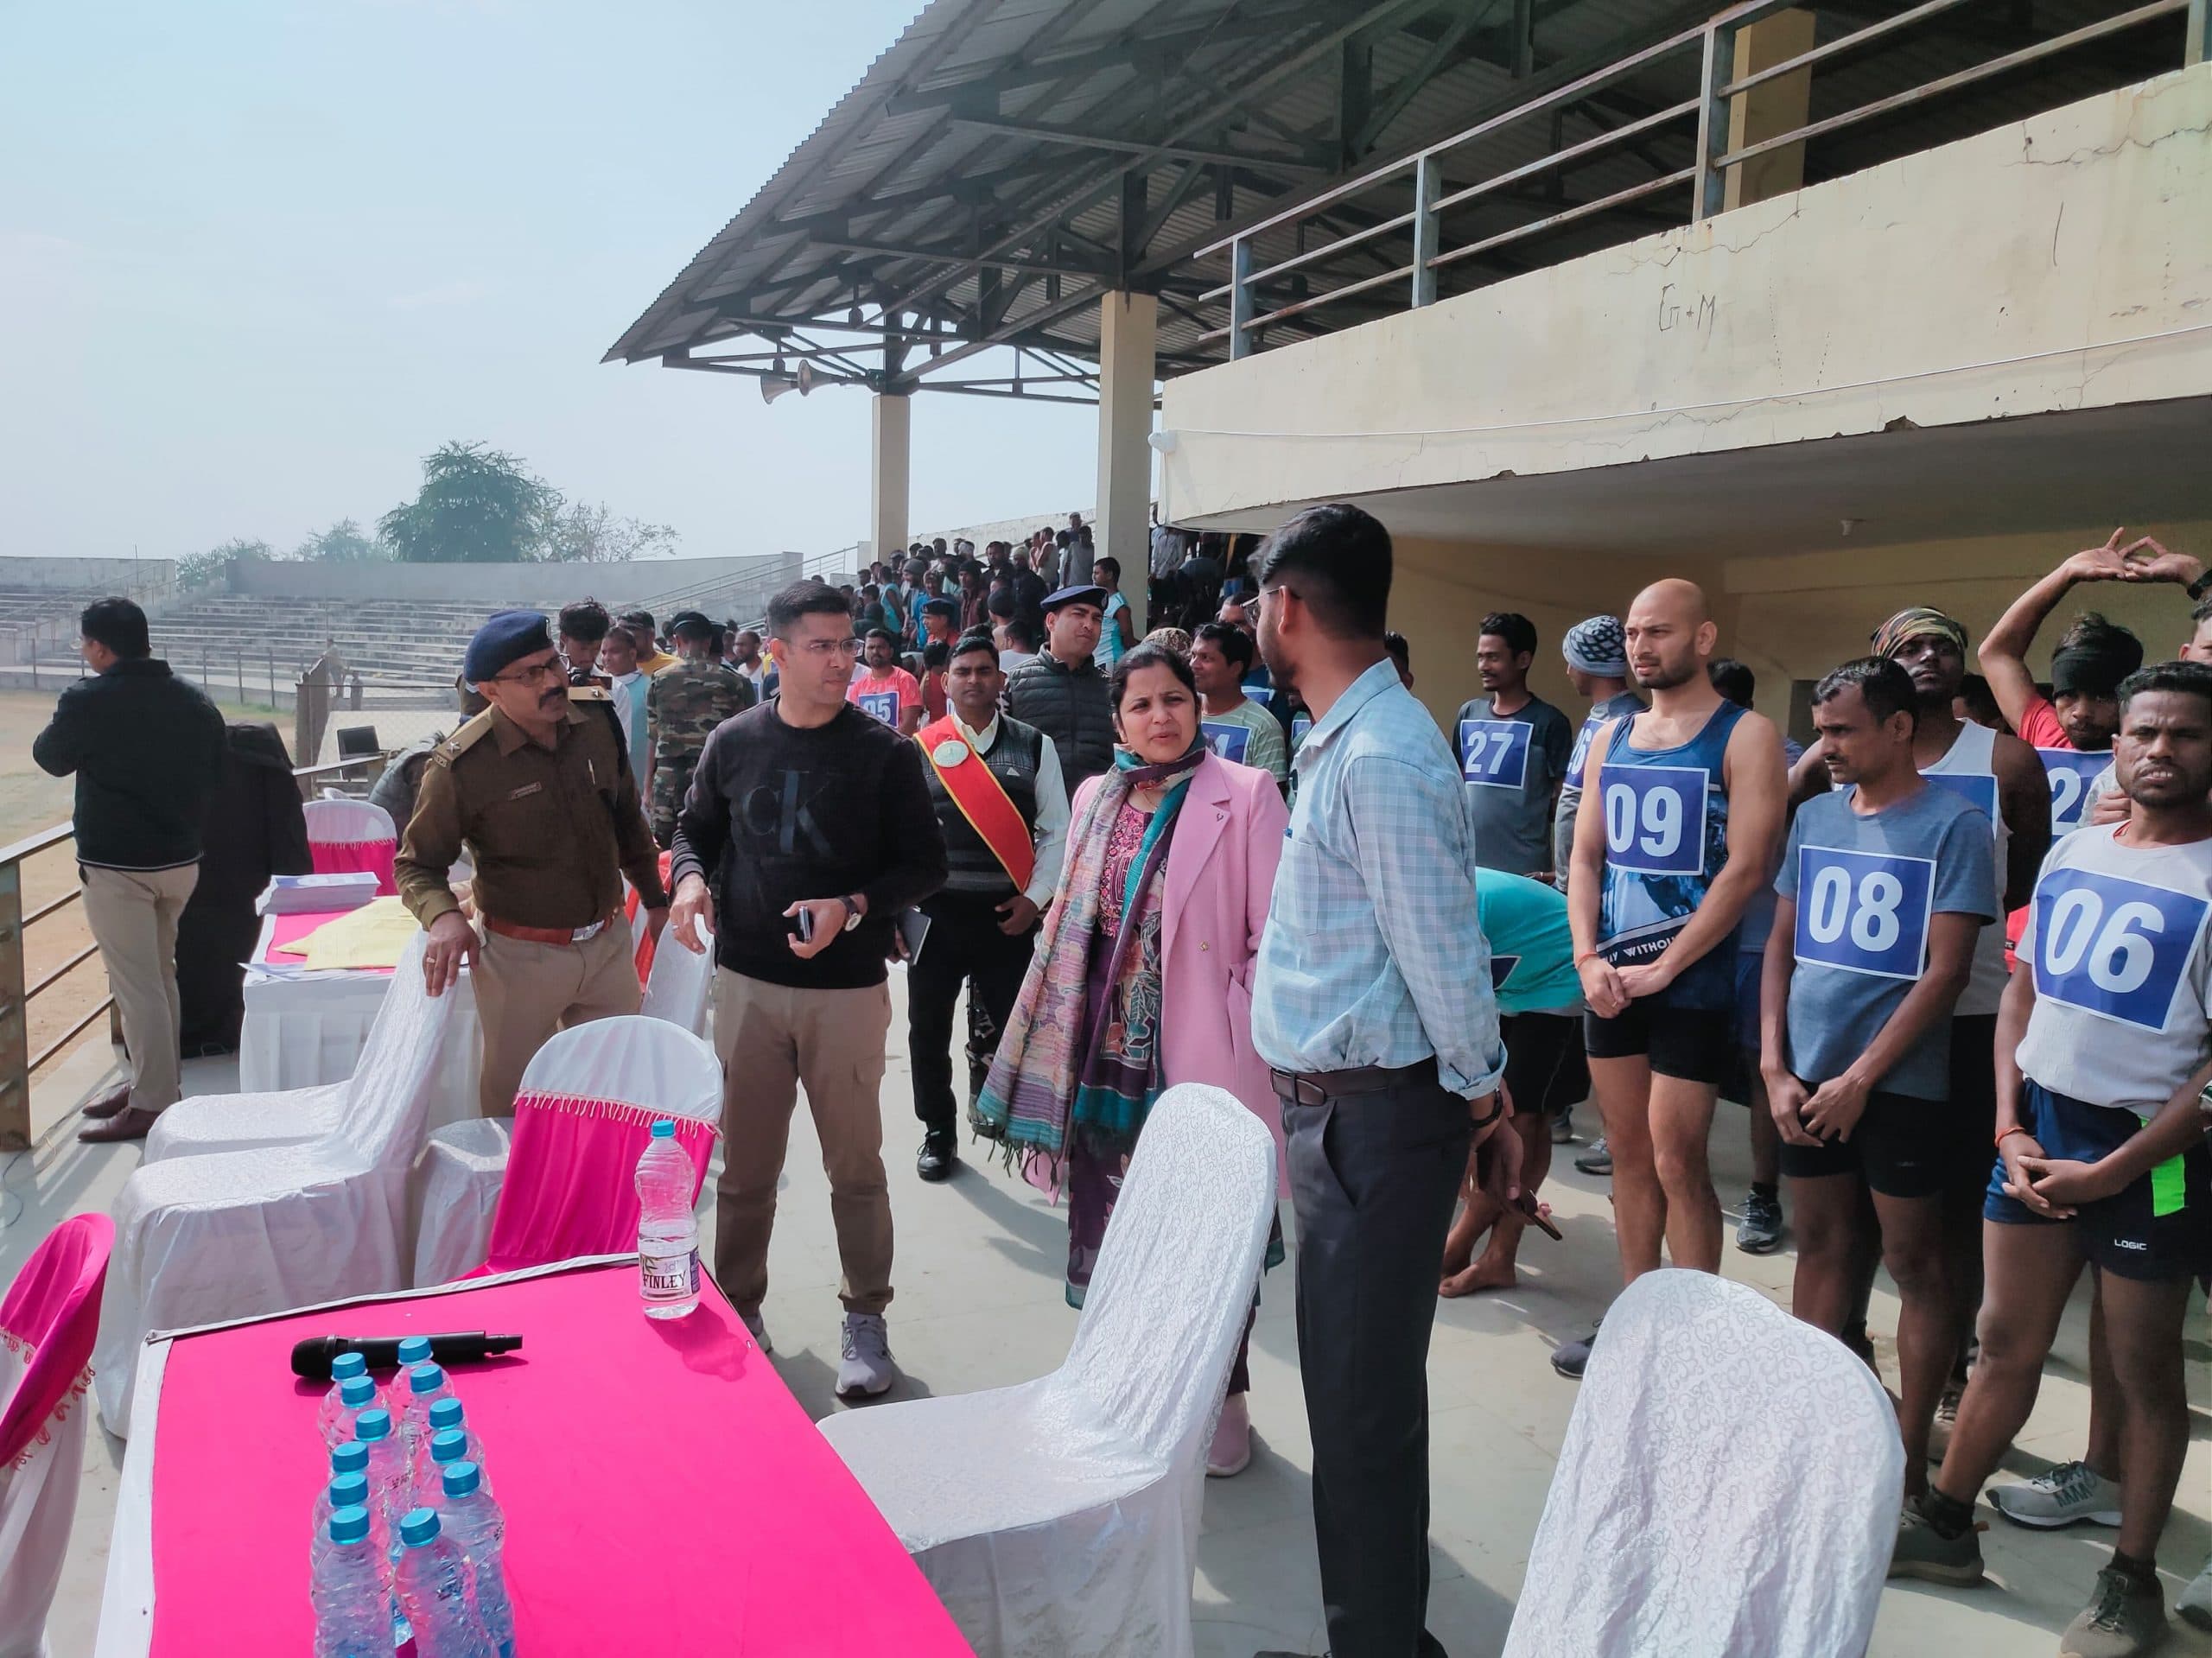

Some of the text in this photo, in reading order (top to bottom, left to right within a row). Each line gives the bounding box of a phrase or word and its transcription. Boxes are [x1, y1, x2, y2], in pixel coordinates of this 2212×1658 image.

[1465, 731, 1514, 774] 27
[1605, 783, 1682, 857] 09
[1808, 866, 1903, 951] 08
[2045, 888, 2164, 993] 06
[2114, 1238, 2147, 1250] LOGIC
[643, 1270, 686, 1289] FINLEY
